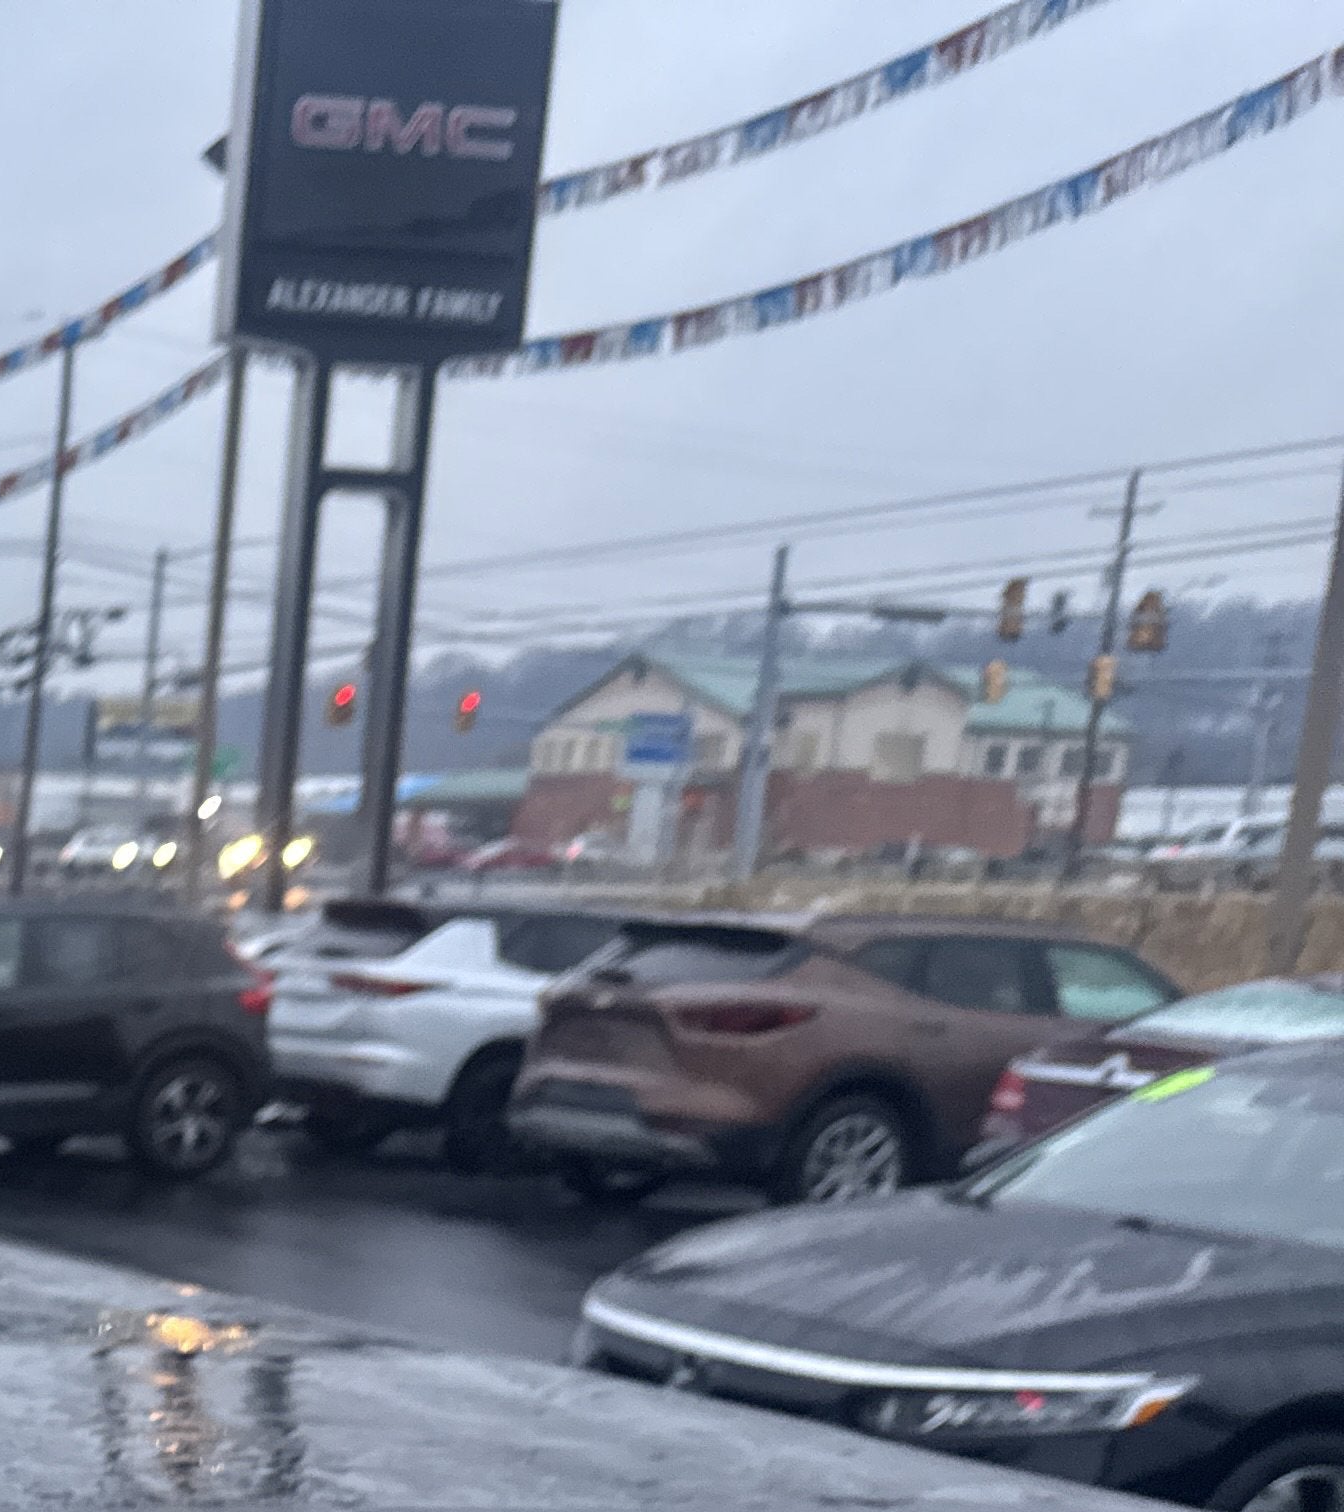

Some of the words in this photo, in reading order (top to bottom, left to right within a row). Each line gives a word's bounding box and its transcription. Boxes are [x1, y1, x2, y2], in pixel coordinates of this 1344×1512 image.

[289, 93, 517, 161] GMC
[266, 277, 409, 318] ALEXANDER
[414, 285, 504, 323] FAMILY
